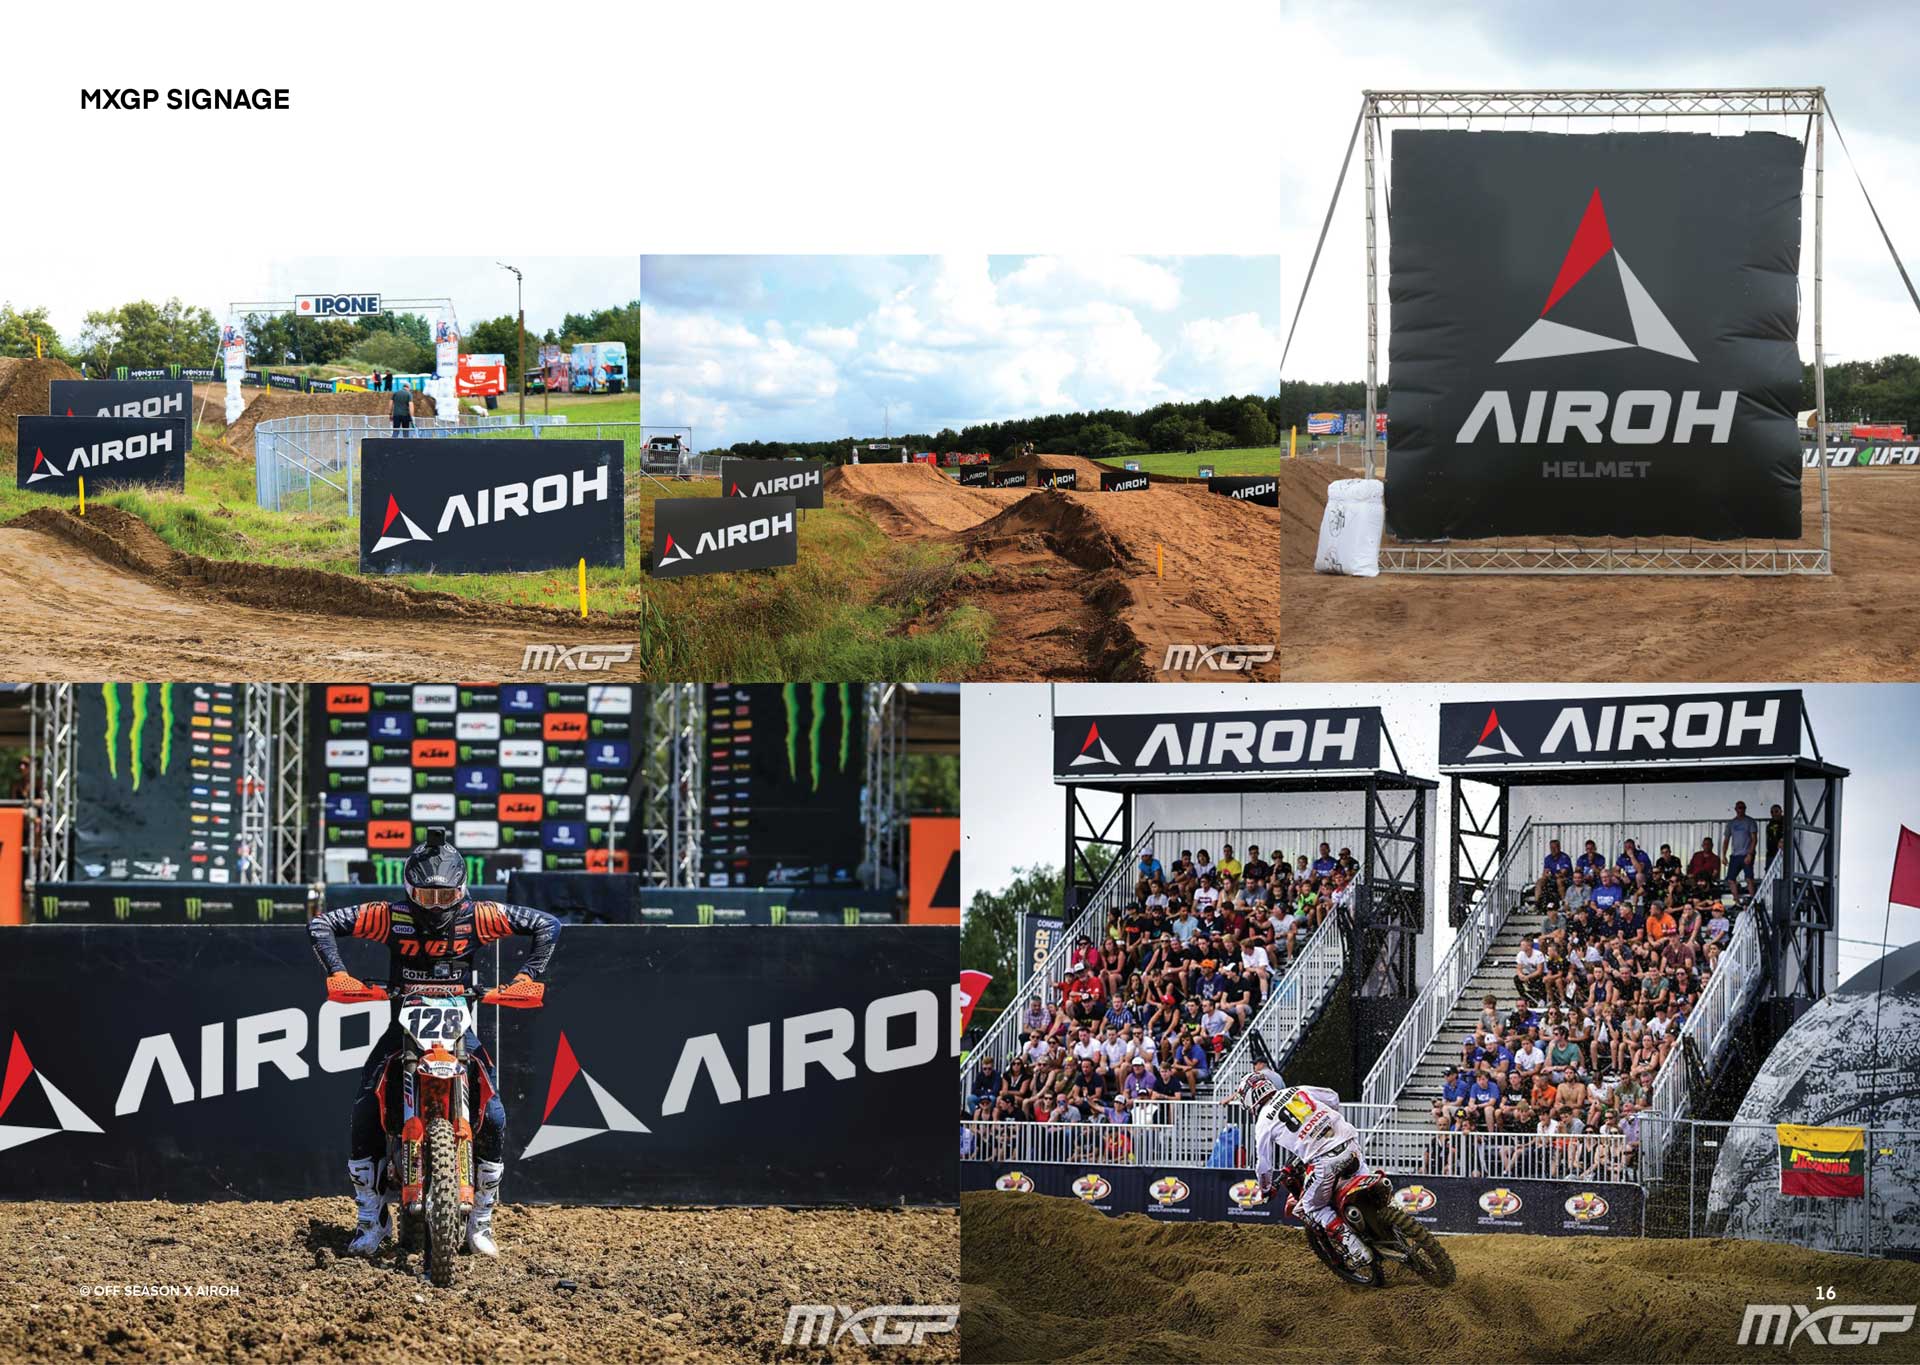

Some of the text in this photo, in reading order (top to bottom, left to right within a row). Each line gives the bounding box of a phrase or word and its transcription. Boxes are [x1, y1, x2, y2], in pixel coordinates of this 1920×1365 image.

[315, 296, 378, 314] IPONE
[131, 369, 165, 377] MONSTER
[1456, 390, 1739, 445] AIROH
[66, 429, 173, 472] AIROH
[1868, 446, 1920, 466] UFO
[752, 470, 820, 498] AIROH
[1048, 473, 1075, 487] AROH
[1115, 477, 1147, 491] AIROH
[1542, 461, 1652, 479] HELMET
[437, 465, 609, 535] AIROH
[1231, 481, 1276, 500] AIROH
[695, 511, 793, 555] AIROH
[1540, 699, 1781, 754] AIROH
[1134, 718, 1361, 767] AIROH
[408, 1007, 464, 1040] 128
[115, 999, 391, 1117] AIRO
[1857, 1071, 1916, 1089] MONSTER
[1297, 1109, 1329, 1141] HONDA
